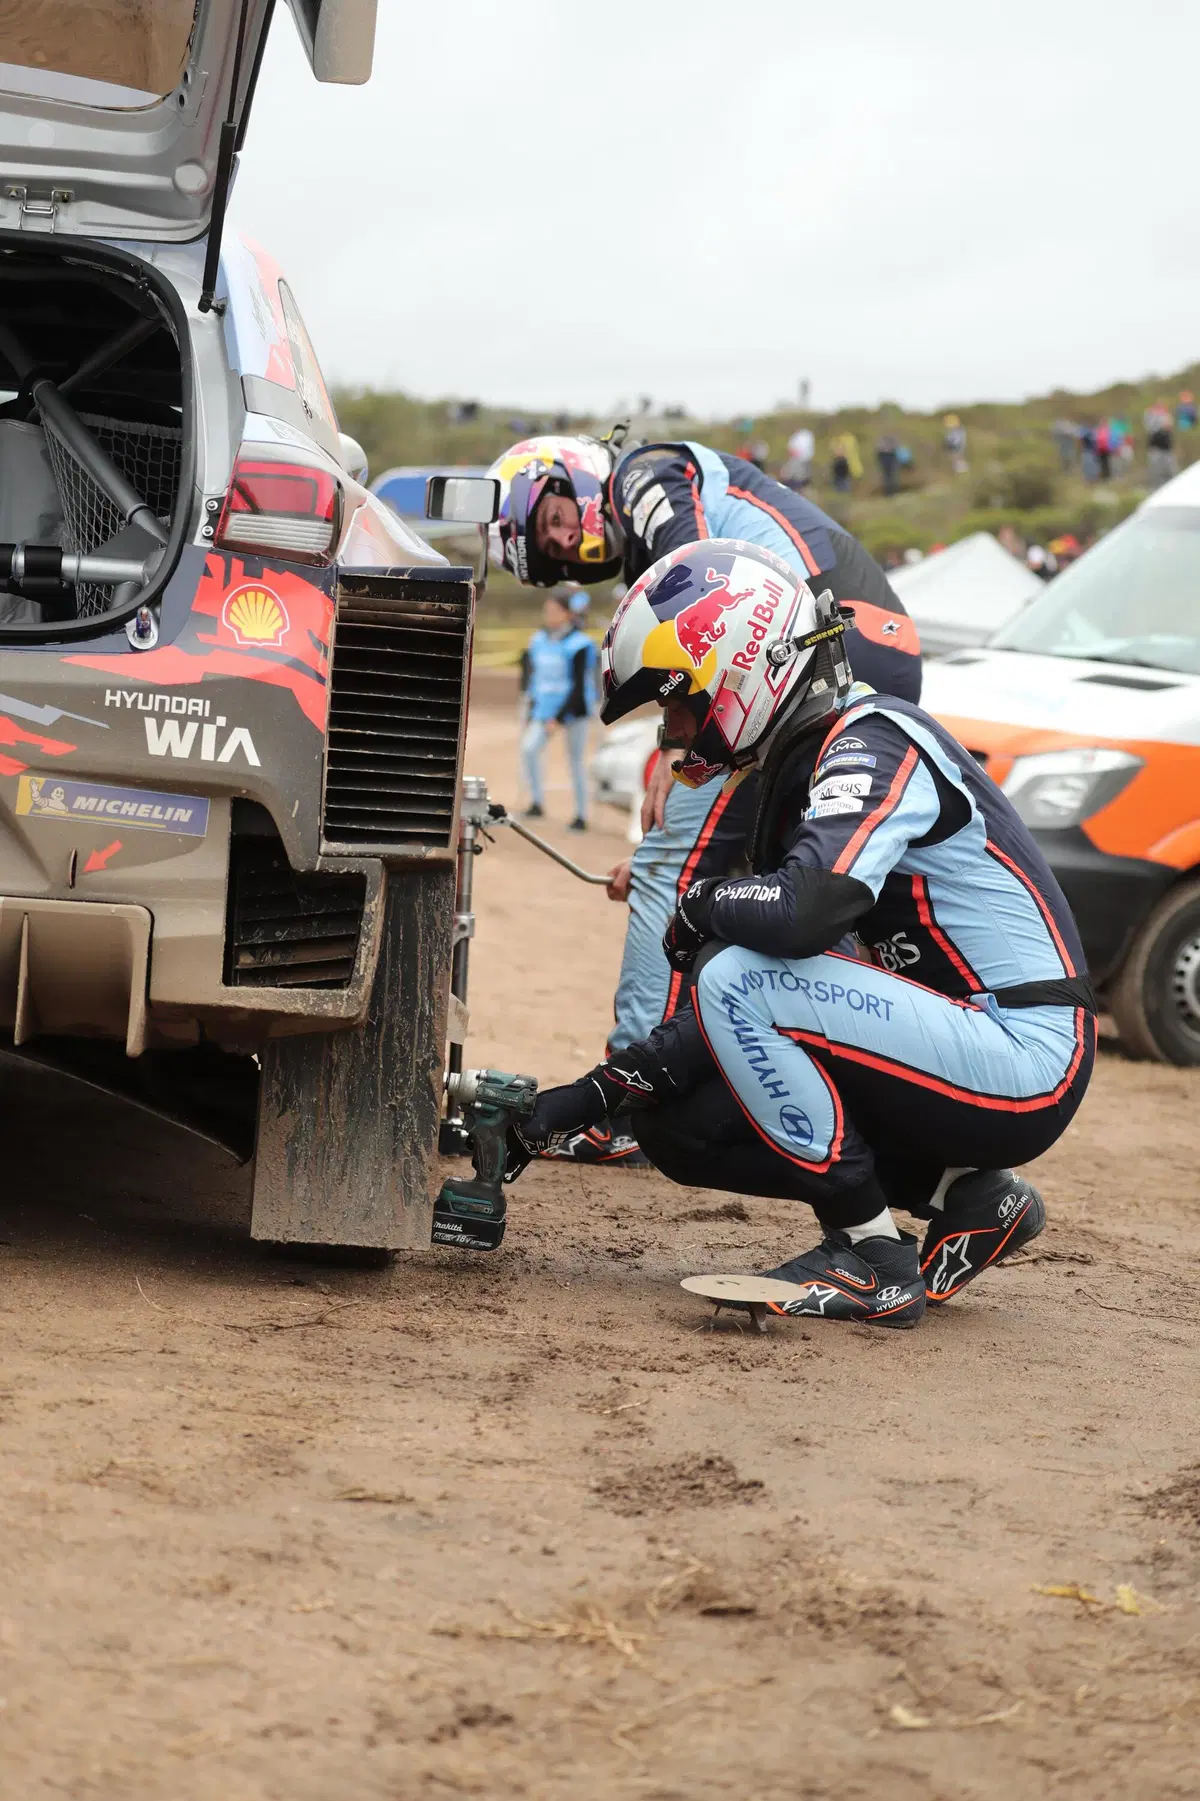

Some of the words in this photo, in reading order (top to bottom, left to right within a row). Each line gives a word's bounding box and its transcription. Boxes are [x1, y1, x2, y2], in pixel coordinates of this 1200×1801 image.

[731, 620, 768, 671] Red
[753, 578, 784, 625] Bull
[659, 671, 685, 696] Stilo
[105, 689, 211, 717] HYUNDAI
[72, 795, 194, 823] MICHELIN
[872, 931, 922, 972] BIS
[729, 969, 895, 1022] MOTORSPORT
[1002, 1194, 1030, 1230] HYUNDAI
[875, 1292, 913, 1313] HYUNDAI
